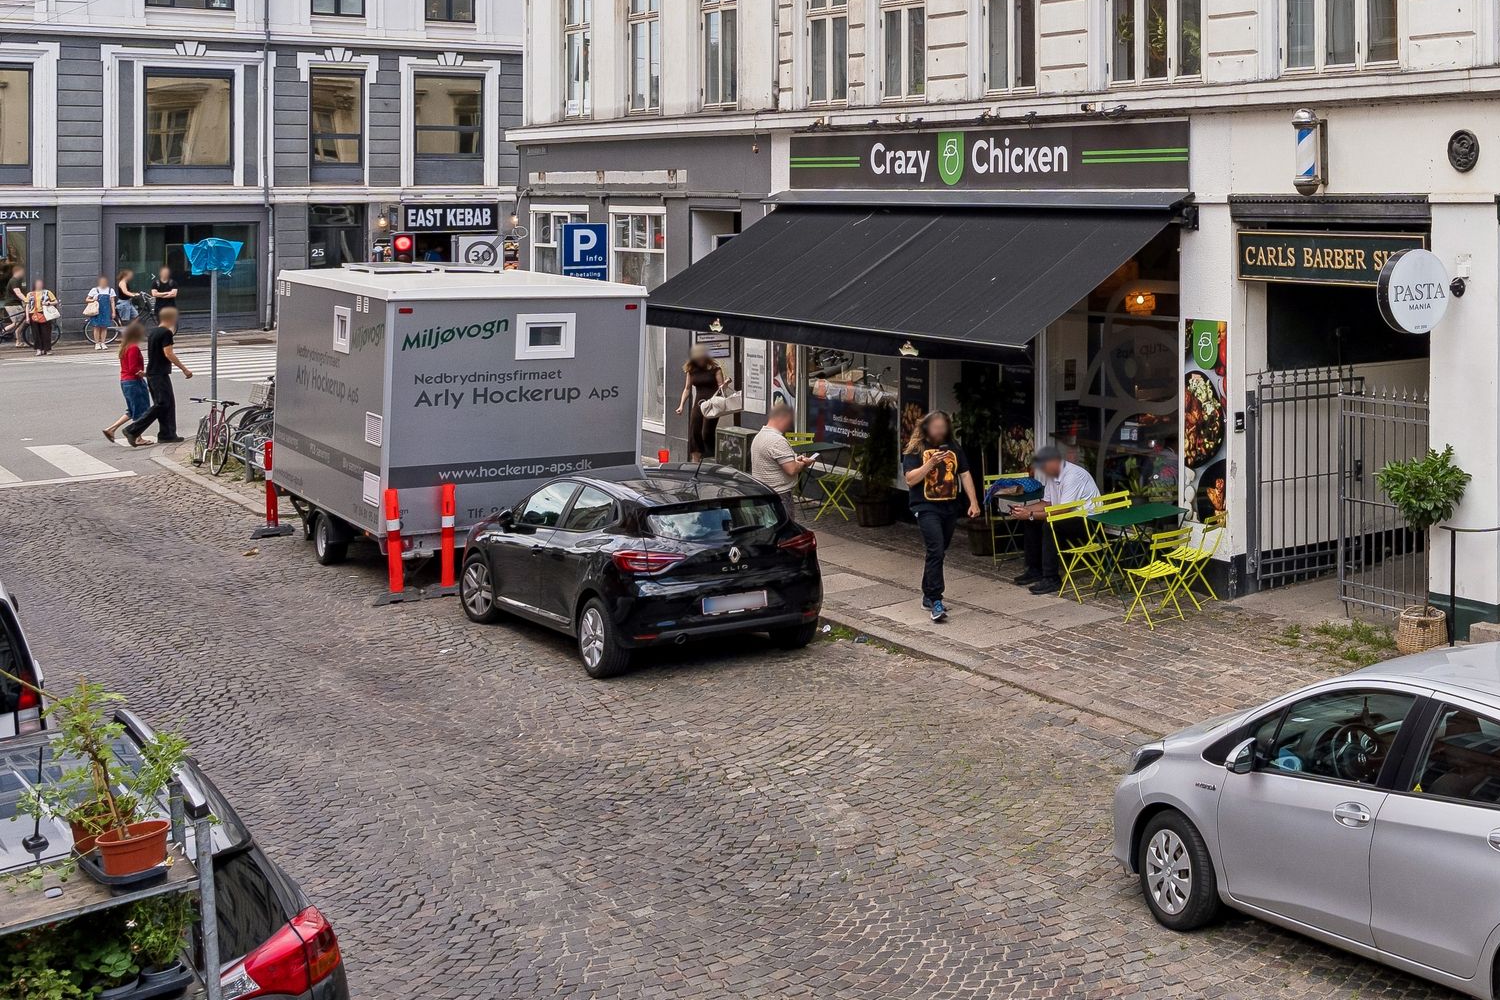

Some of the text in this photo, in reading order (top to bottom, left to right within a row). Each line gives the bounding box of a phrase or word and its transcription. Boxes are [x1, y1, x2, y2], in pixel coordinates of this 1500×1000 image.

[870, 137, 1068, 183] Crazy Chicken
[0, 210, 40, 220] BANK
[407, 207, 492, 227] EAST KEBAB
[311, 248, 325, 258] 25
[471, 249, 492, 262] 30
[573, 229, 598, 263] P
[1245, 243, 1296, 268] CARL'S
[1303, 247, 1367, 271] BARBER
[1393, 282, 1446, 303] PASTA
[1408, 302, 1432, 311] MANIA
[401, 317, 509, 351] Miljøvogn
[296, 364, 312, 391] Arly
[311, 367, 346, 403] Hockerup
[414, 368, 563, 386] Nedbrydningsfirmaet
[414, 385, 620, 409] Arly Hockerup ApS
[438, 458, 593, 480] www.hockerup-aps.dk
[467, 507, 486, 519] Tlf.
[721, 564, 749, 572] CLIO
